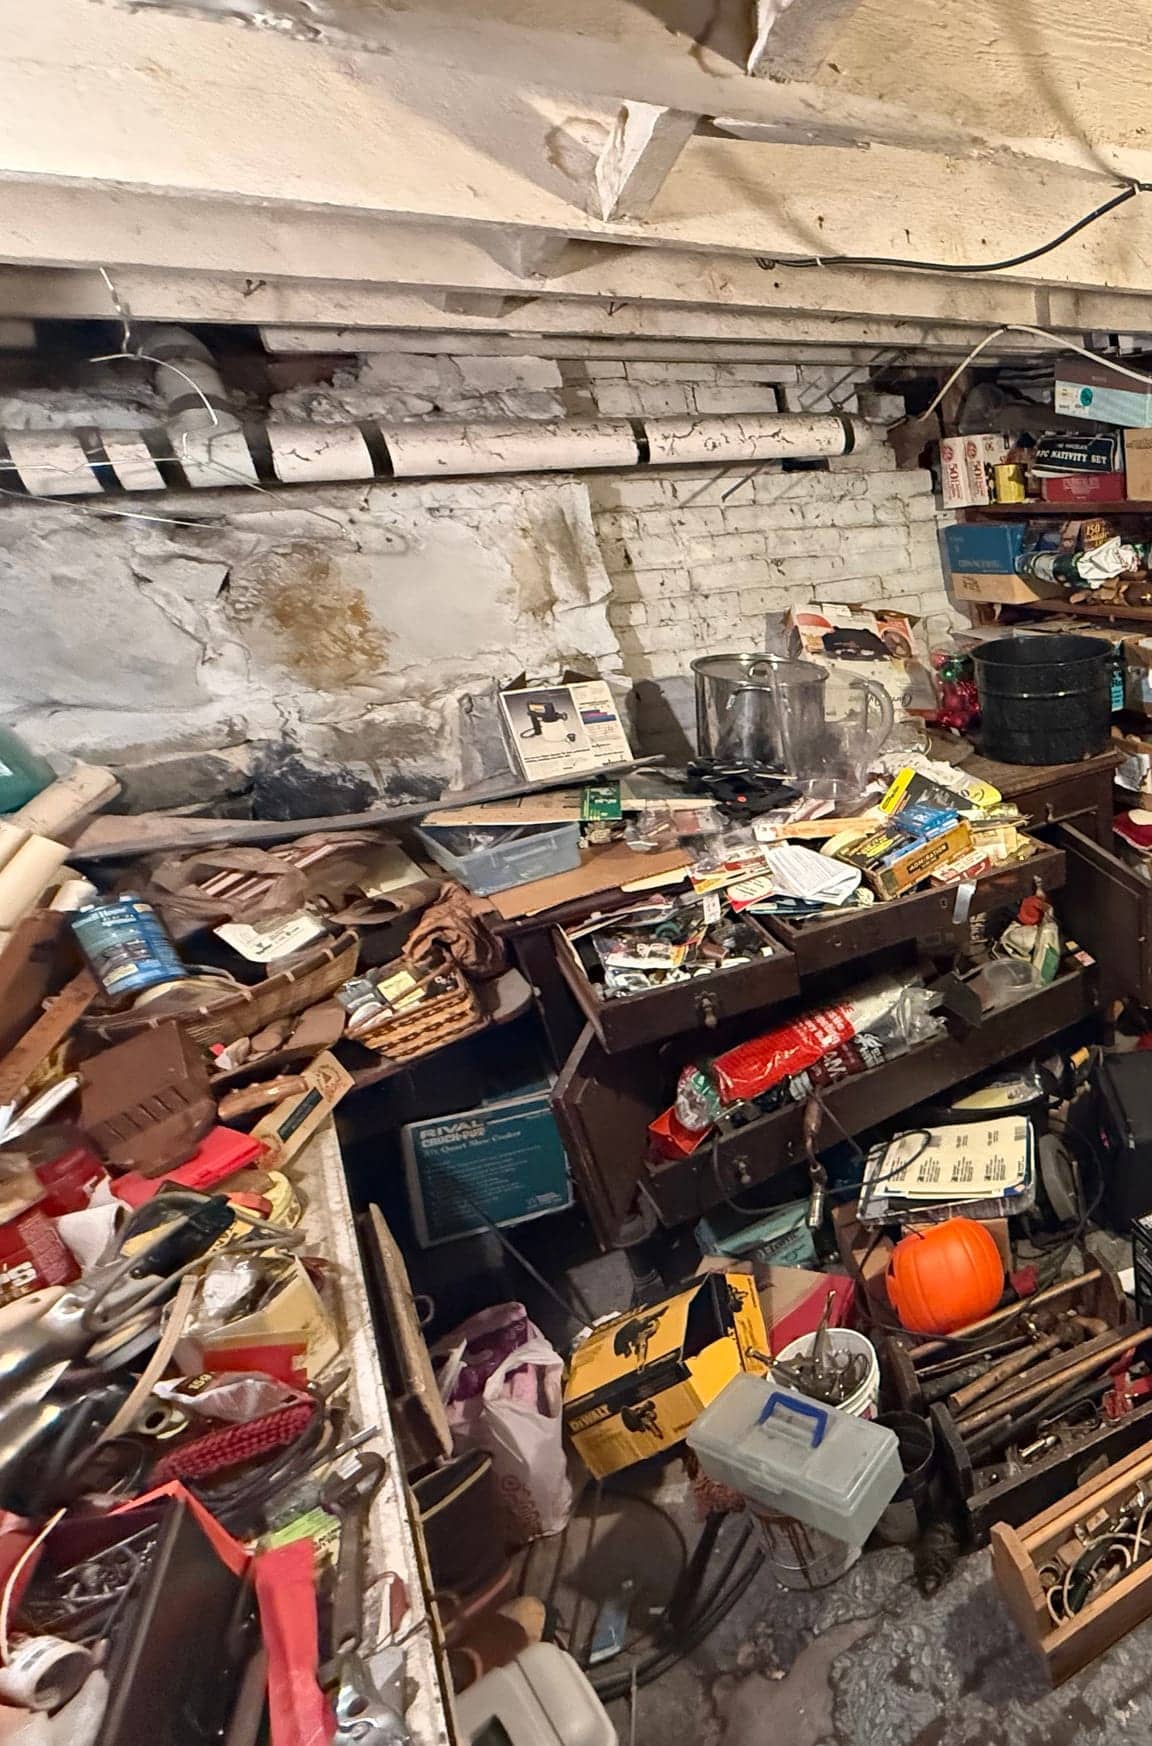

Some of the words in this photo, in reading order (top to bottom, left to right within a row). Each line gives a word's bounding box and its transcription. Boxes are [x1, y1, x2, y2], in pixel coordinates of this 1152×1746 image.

[1051, 450, 1088, 463] NATIVITY
[1091, 454, 1107, 465] SET
[419, 1119, 486, 1140] RIVAL
